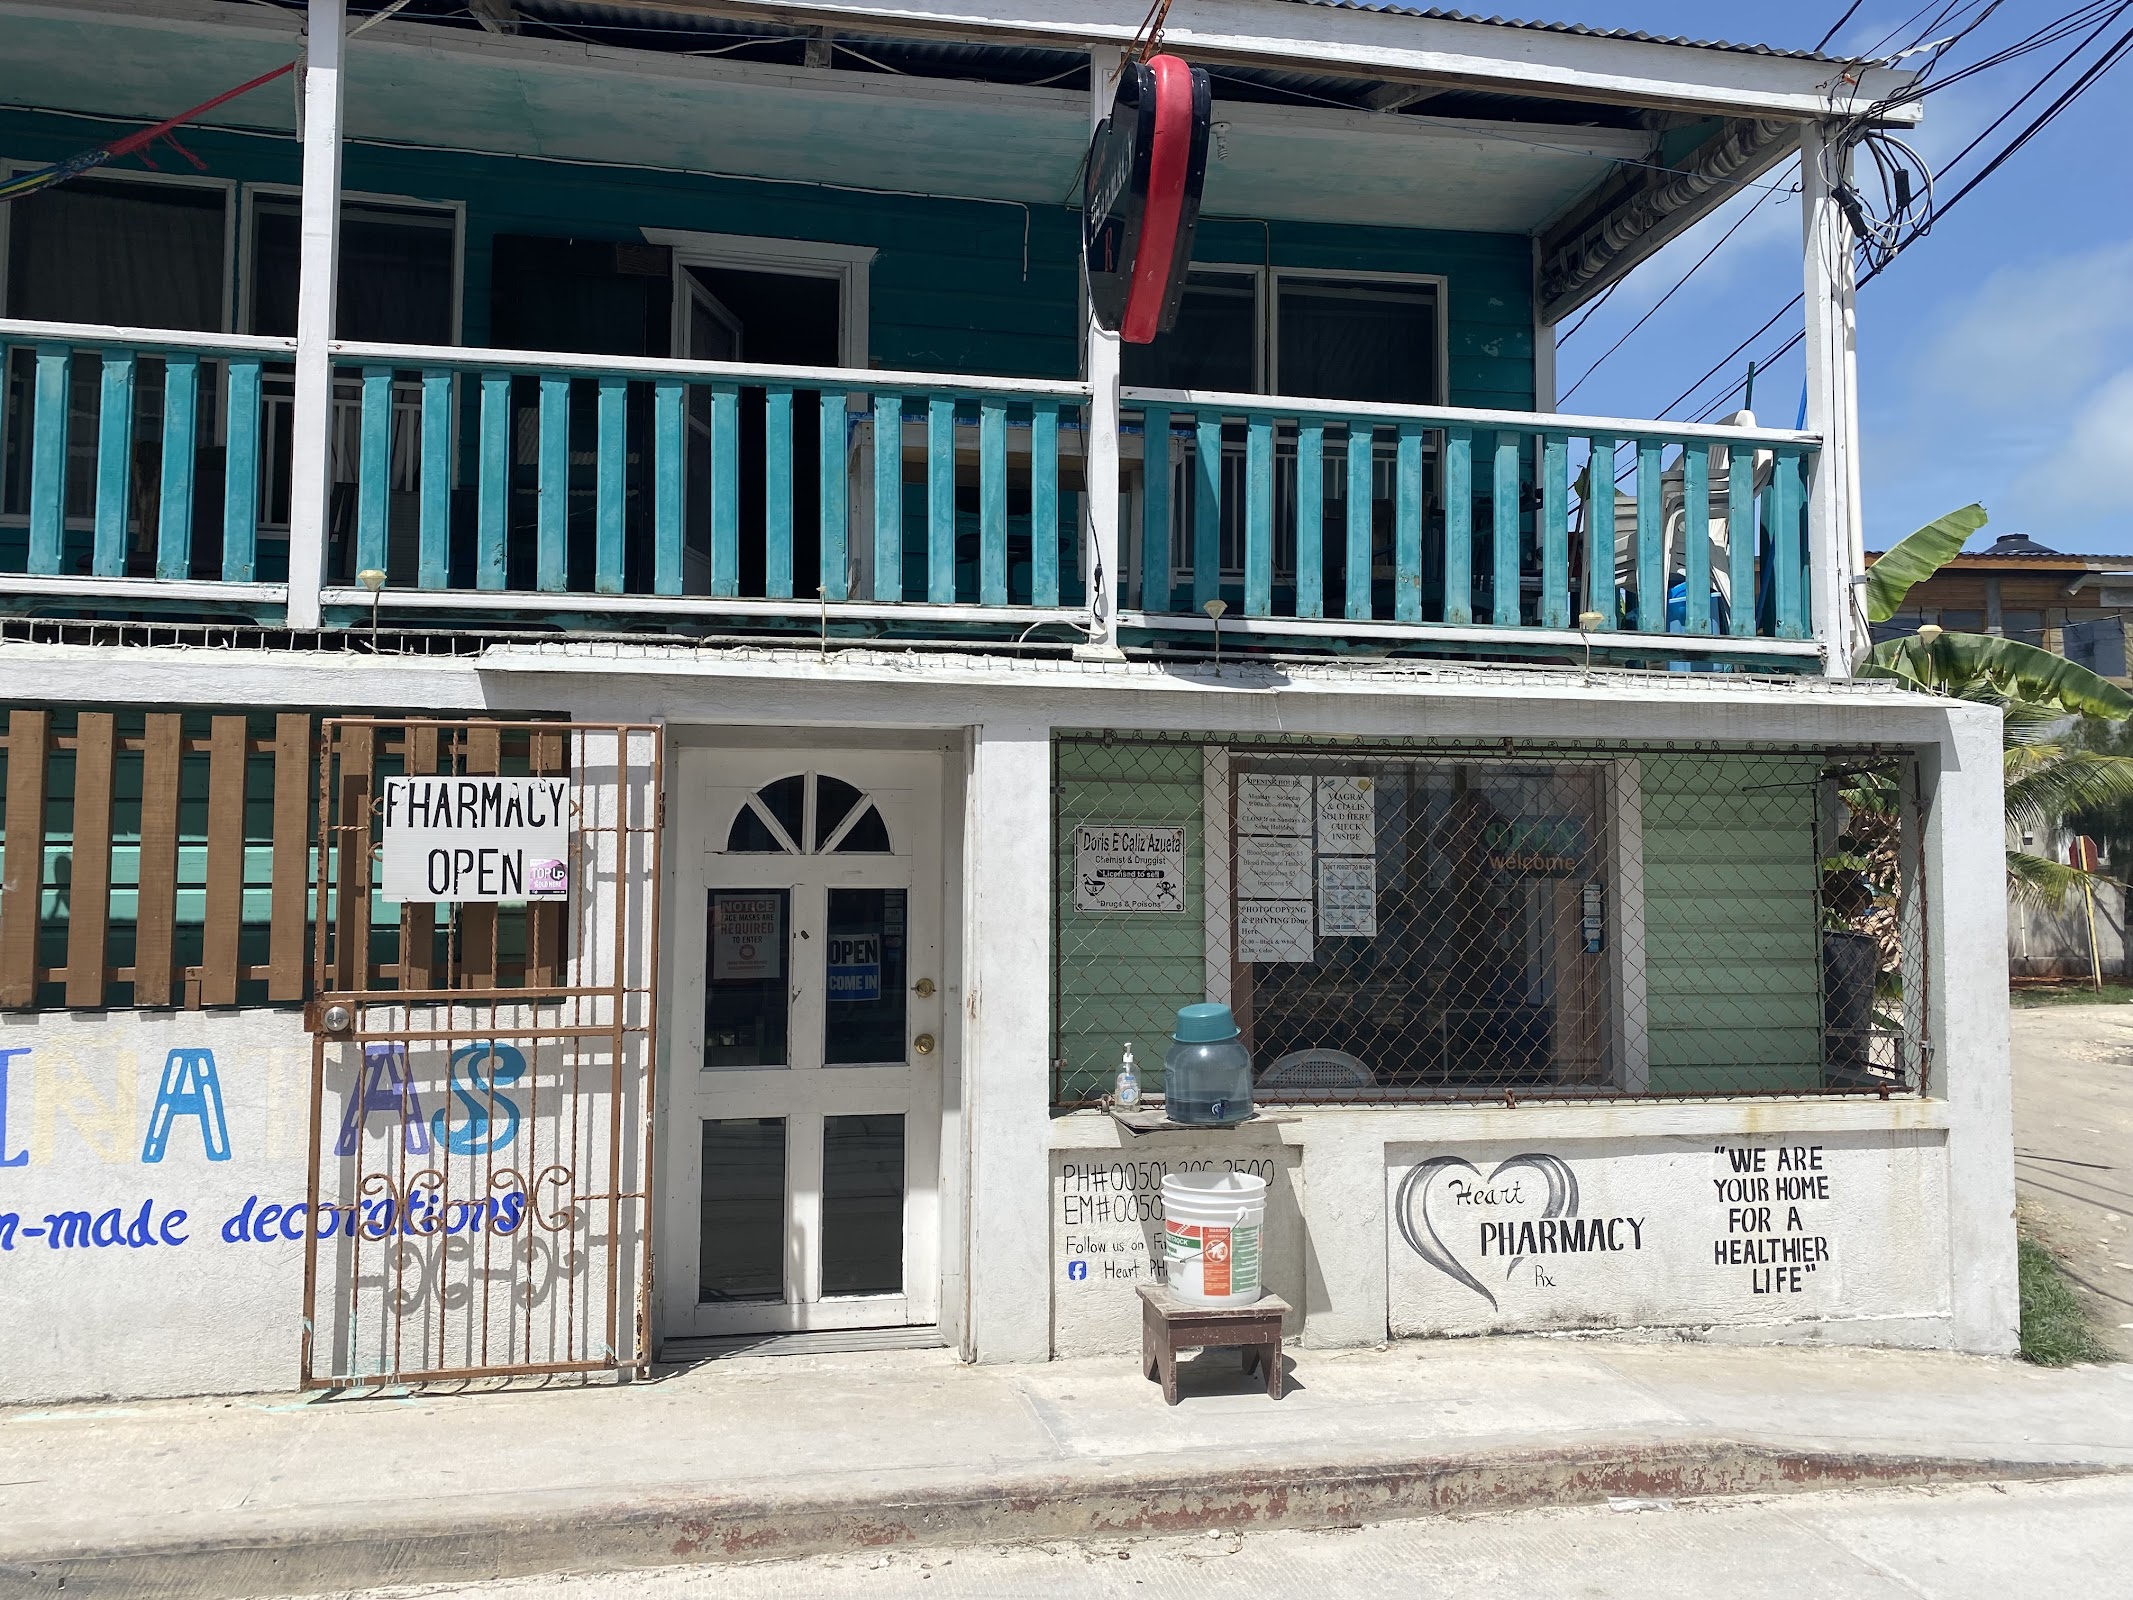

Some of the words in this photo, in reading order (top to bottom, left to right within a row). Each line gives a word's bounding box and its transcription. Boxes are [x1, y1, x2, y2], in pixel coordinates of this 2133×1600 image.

[1083, 832, 1109, 851] Doris
[1113, 832, 1119, 851] E
[1122, 833, 1145, 852] Caliz
[428, 848, 523, 895] OPEN
[1095, 855, 1125, 864] Chemist
[1127, 856, 1133, 864] &
[1134, 856, 1166, 866] Druggist
[1489, 853, 1575, 870] welcome
[533, 867, 551, 879] TOP
[721, 901, 774, 912] NOTICE
[721, 913, 737, 921] FACE
[738, 913, 760, 921] MASKS
[761, 913, 774, 921] ARE
[720, 922, 774, 935] REQUIRED
[732, 936, 741, 944] TO
[743, 936, 763, 944] ENTER
[828, 940, 878, 964] OPEN
[829, 975, 863, 991] COME
[864, 974, 878, 990] IN
[1713, 1145, 1766, 1173] "WE
[1776, 1145, 1824, 1172] ARE
[1448, 1179, 1525, 1205] Heart
[1713, 1178, 1769, 1203] YOUR
[1776, 1176, 1830, 1202] HOME
[221, 1191, 526, 1249] decorations
[1064, 1195, 1166, 1225] EM#0050
[1729, 1207, 1771, 1233] FOR
[1786, 1207, 1803, 1232] A
[1066, 1235, 1106, 1254] Follow
[1113, 1243, 1125, 1253] us
[1131, 1241, 1144, 1250] on
[1480, 1217, 1646, 1257] PHARMACY
[1713, 1237, 1830, 1266] HEALTHIER
[1104, 1260, 1141, 1279] Heart
[1535, 1265, 1556, 1288] Rx
[1752, 1263, 1818, 1295] LIFE"
